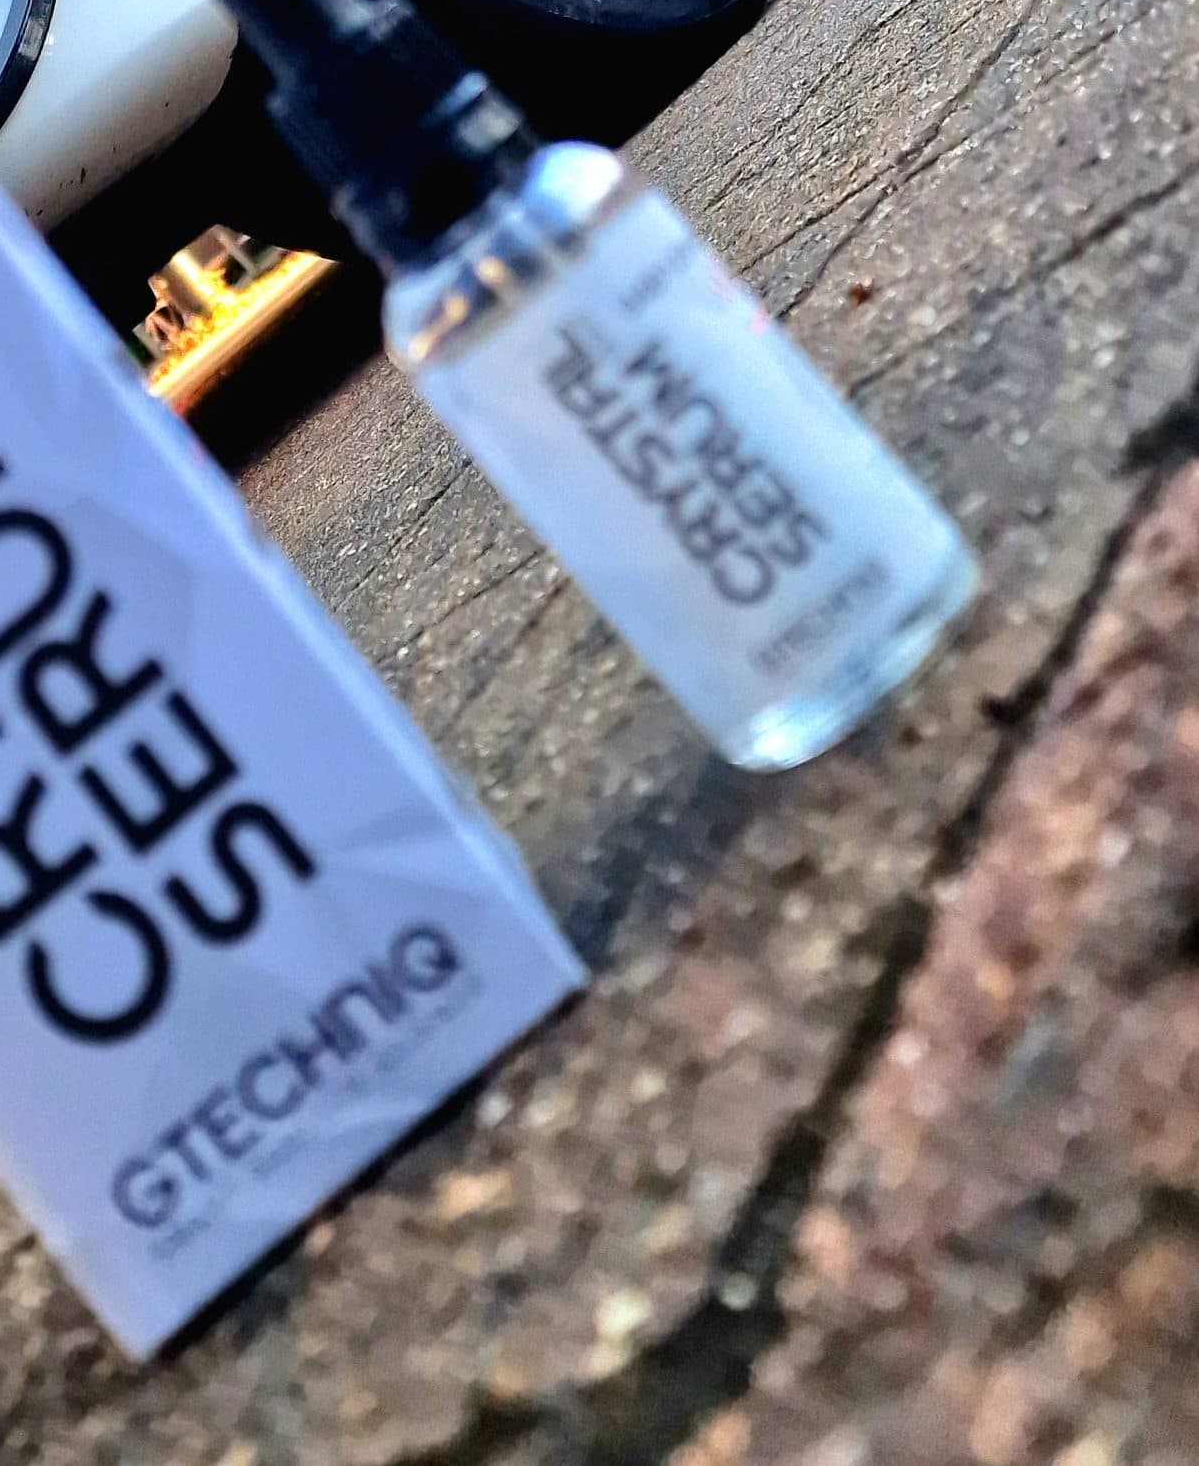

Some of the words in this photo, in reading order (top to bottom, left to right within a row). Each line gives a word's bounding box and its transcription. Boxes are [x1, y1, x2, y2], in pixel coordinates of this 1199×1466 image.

[539, 318, 777, 607] CRYSTAL
[620, 341, 829, 569] SERUM
[112, 925, 459, 1228] GTECHNIQ
